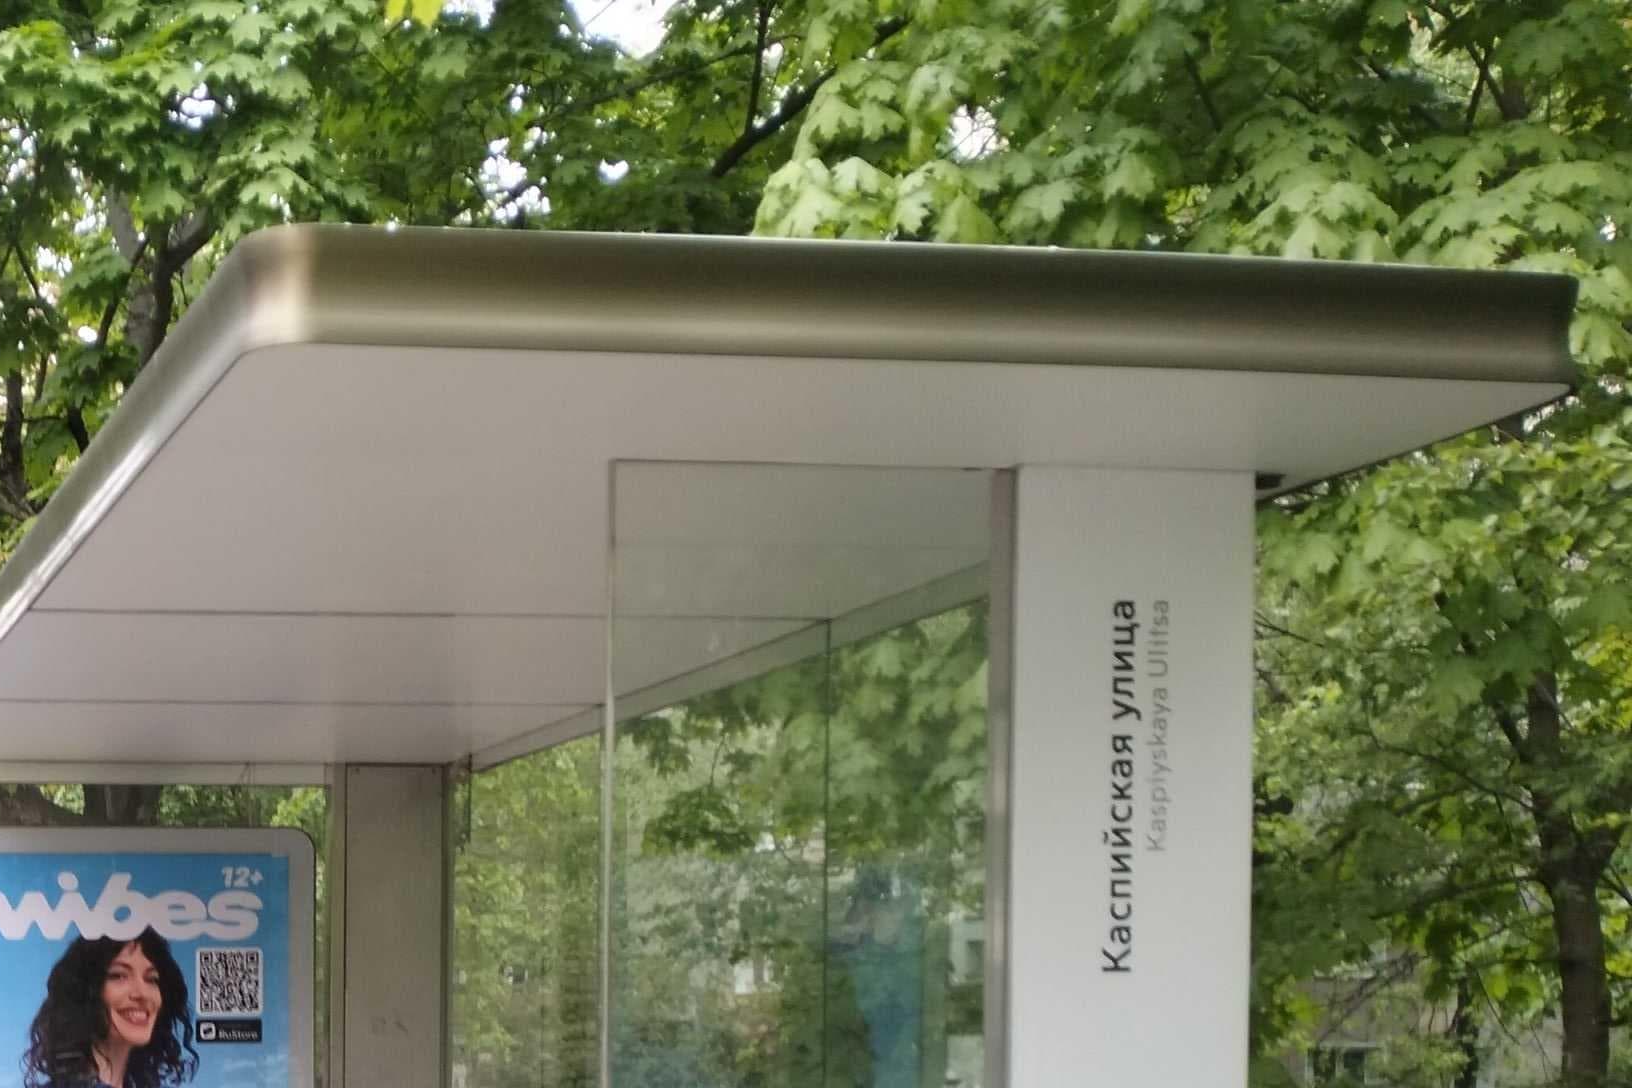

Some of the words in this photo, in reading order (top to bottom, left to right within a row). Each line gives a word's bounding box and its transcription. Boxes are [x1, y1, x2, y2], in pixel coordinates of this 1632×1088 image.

[1112, 600, 1141, 721] улица
[1147, 600, 1169, 678] Ulitsa
[1146, 687, 1172, 852] Kaspiyskaya
[222, 867, 264, 888] 12+
[1102, 735, 1134, 973] Каспийская
